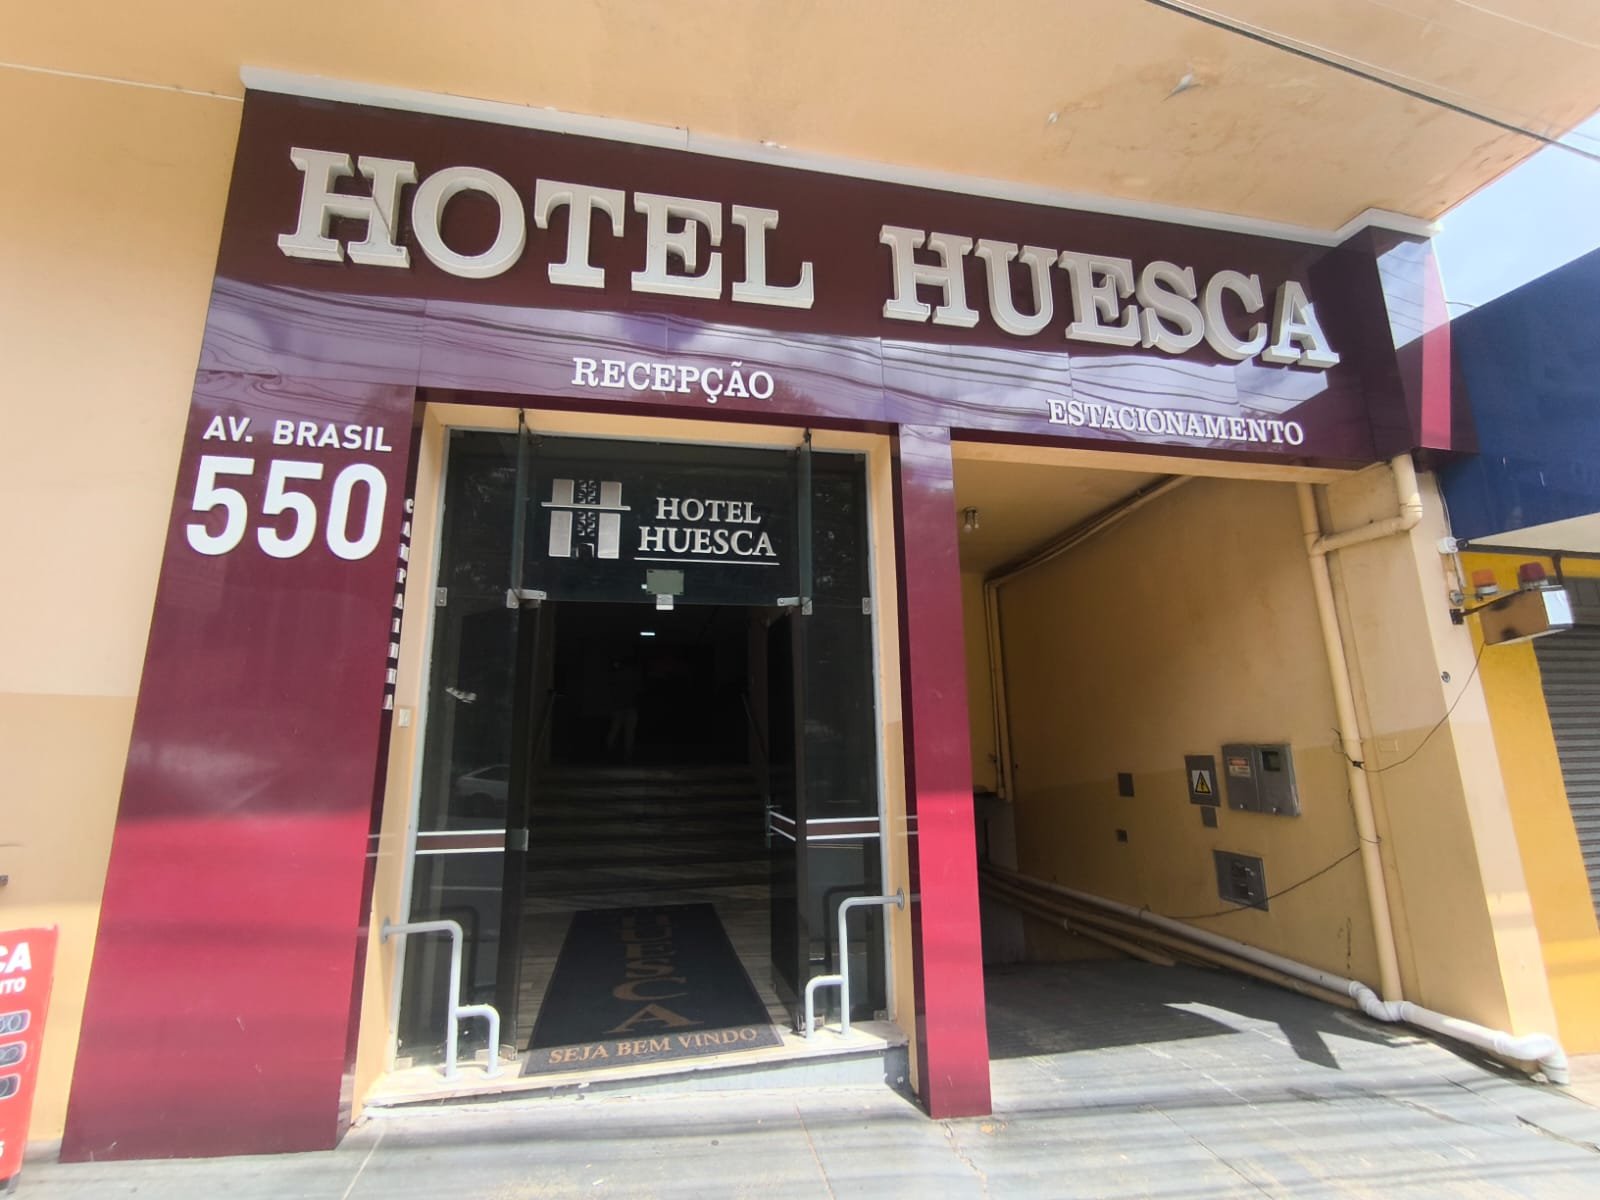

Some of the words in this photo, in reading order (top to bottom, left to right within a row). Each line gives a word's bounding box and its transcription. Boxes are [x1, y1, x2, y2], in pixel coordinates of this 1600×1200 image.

[277, 147, 814, 309] HOTEL
[879, 225, 1340, 368] HUESCA
[571, 357, 775, 404] RECEPÇÃO
[202, 415, 253, 443] AV.
[272, 419, 393, 453] BRASIL
[1046, 399, 1305, 446] ESTACIONAMENTO
[186, 455, 388, 560] 550
[655, 496, 761, 524] HOTEL
[637, 526, 777, 556] HUESCA
[548, 1043, 609, 1065] SEJA
[615, 1037, 672, 1057] BEM
[678, 1028, 758, 1049] VINDO
